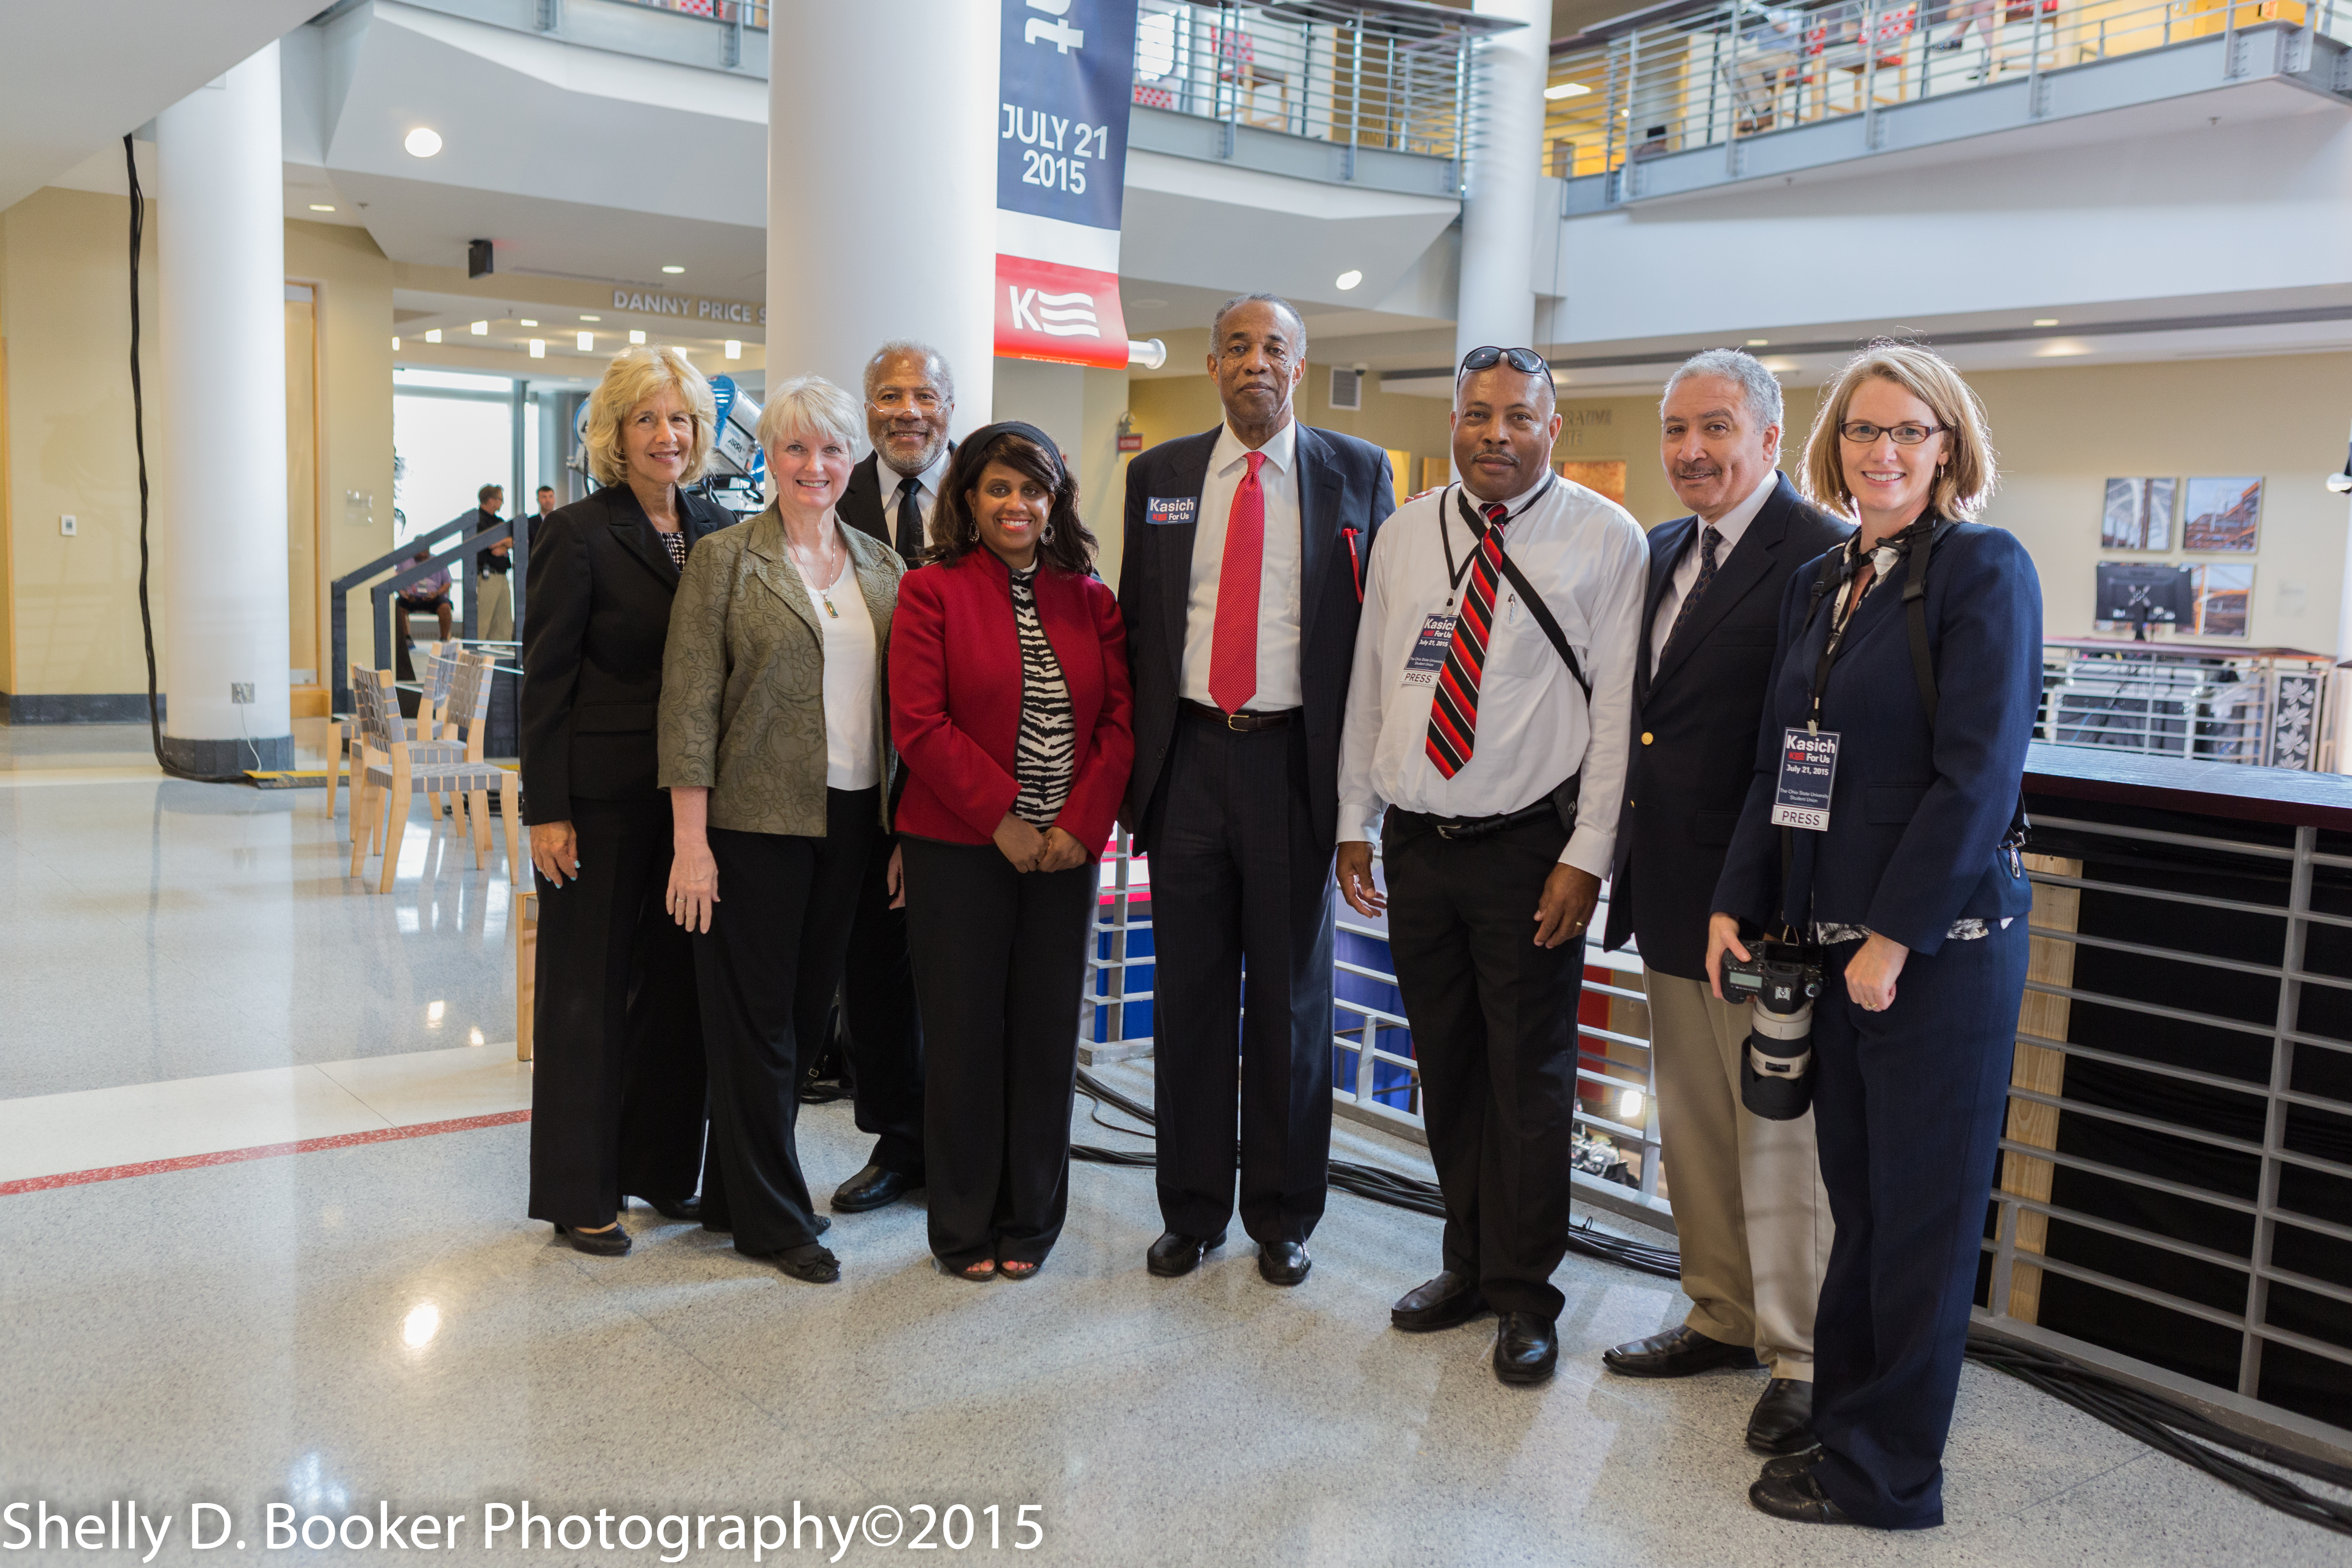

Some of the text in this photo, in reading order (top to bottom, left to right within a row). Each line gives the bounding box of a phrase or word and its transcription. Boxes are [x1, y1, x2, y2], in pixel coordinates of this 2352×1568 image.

[1002, 103, 1108, 160] JULY 21
[1022, 149, 1086, 194] 2015
[613, 290, 692, 316] DANNY
[698, 300, 751, 323] PRICE
[728, 438, 742, 453] ARRI
[1150, 499, 1194, 512] Kasich
[1404, 673, 1432, 683] PRESS
[1786, 735, 1836, 754] Kasich
[1806, 753, 1819, 762] For
[1819, 754, 1830, 764] Us
[1786, 764, 1801, 774] July
[1802, 766, 1811, 775] 21,
[1782, 811, 1820, 826] PRESS
